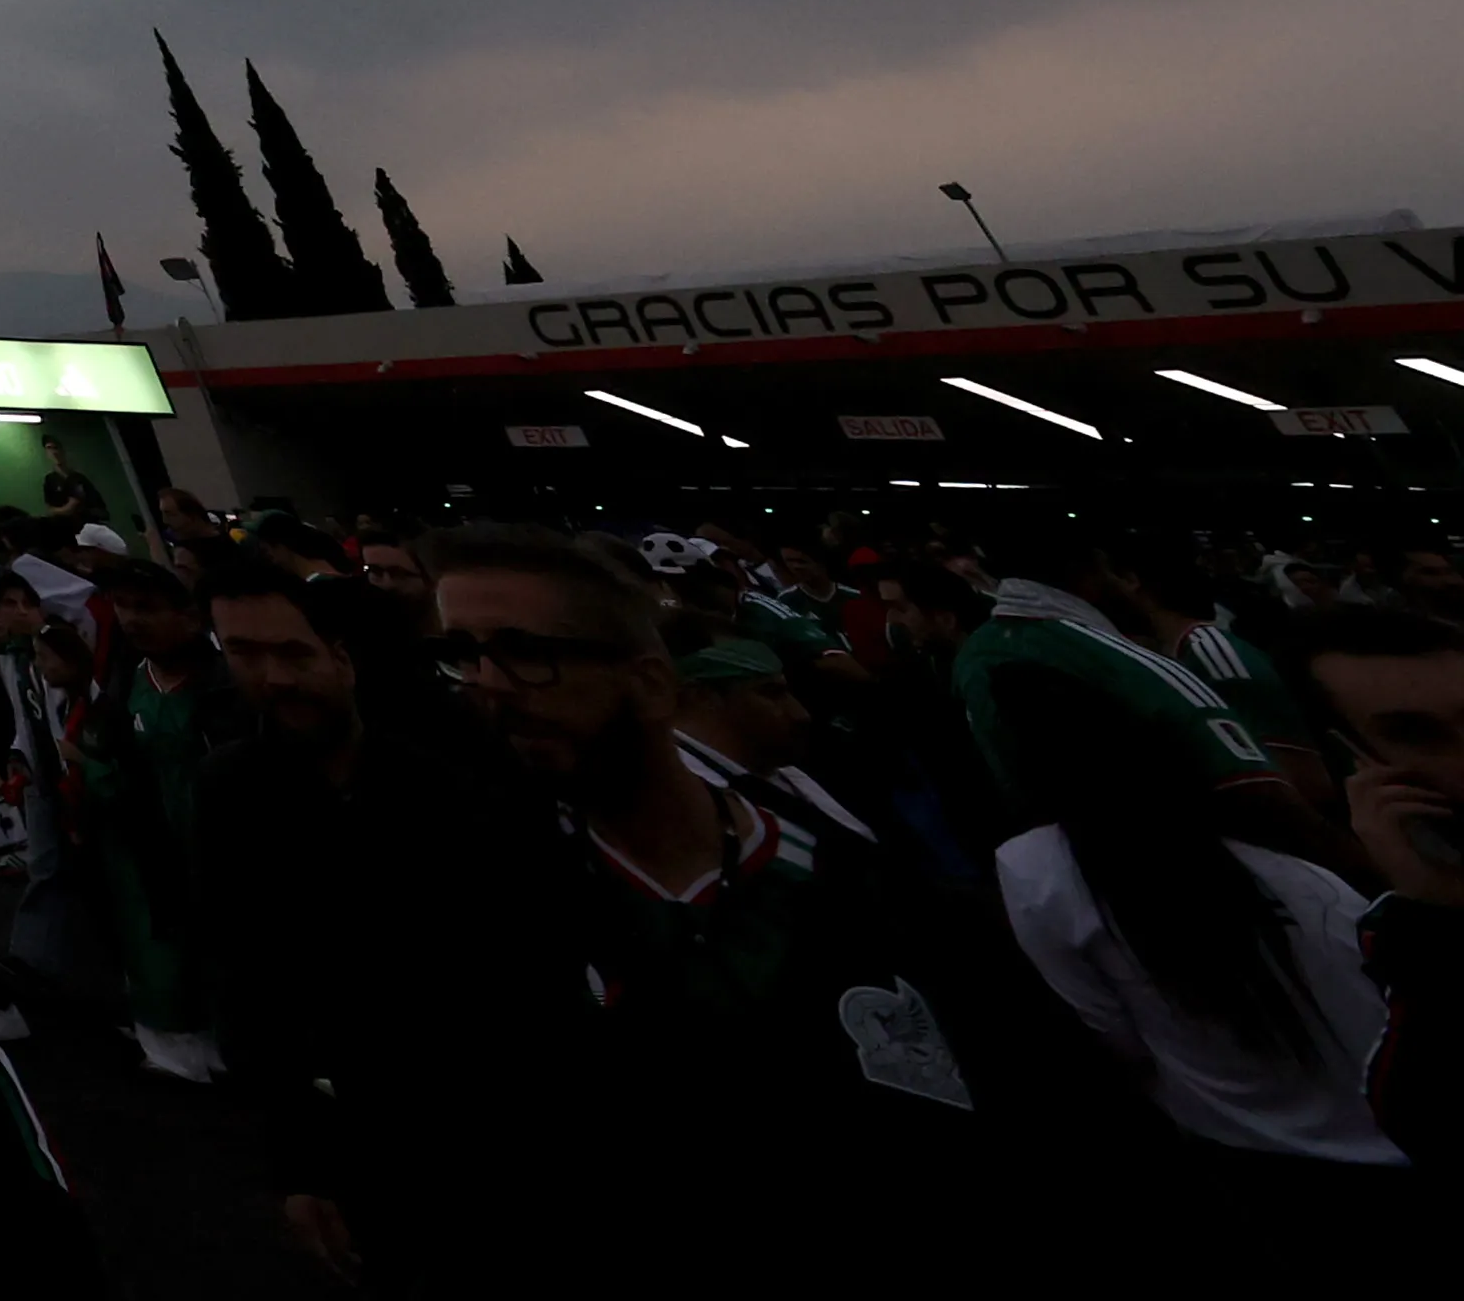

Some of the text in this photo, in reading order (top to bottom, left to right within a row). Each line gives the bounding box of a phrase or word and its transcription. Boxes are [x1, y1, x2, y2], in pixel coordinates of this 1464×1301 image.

[529, 282, 893, 348] GRACIAS
[921, 263, 1155, 324] POR
[1183, 246, 1350, 308] SU
[845, 419, 939, 440] SALIDA
[1302, 408, 1377, 435] EXIT
[523, 427, 571, 446] EXIT
